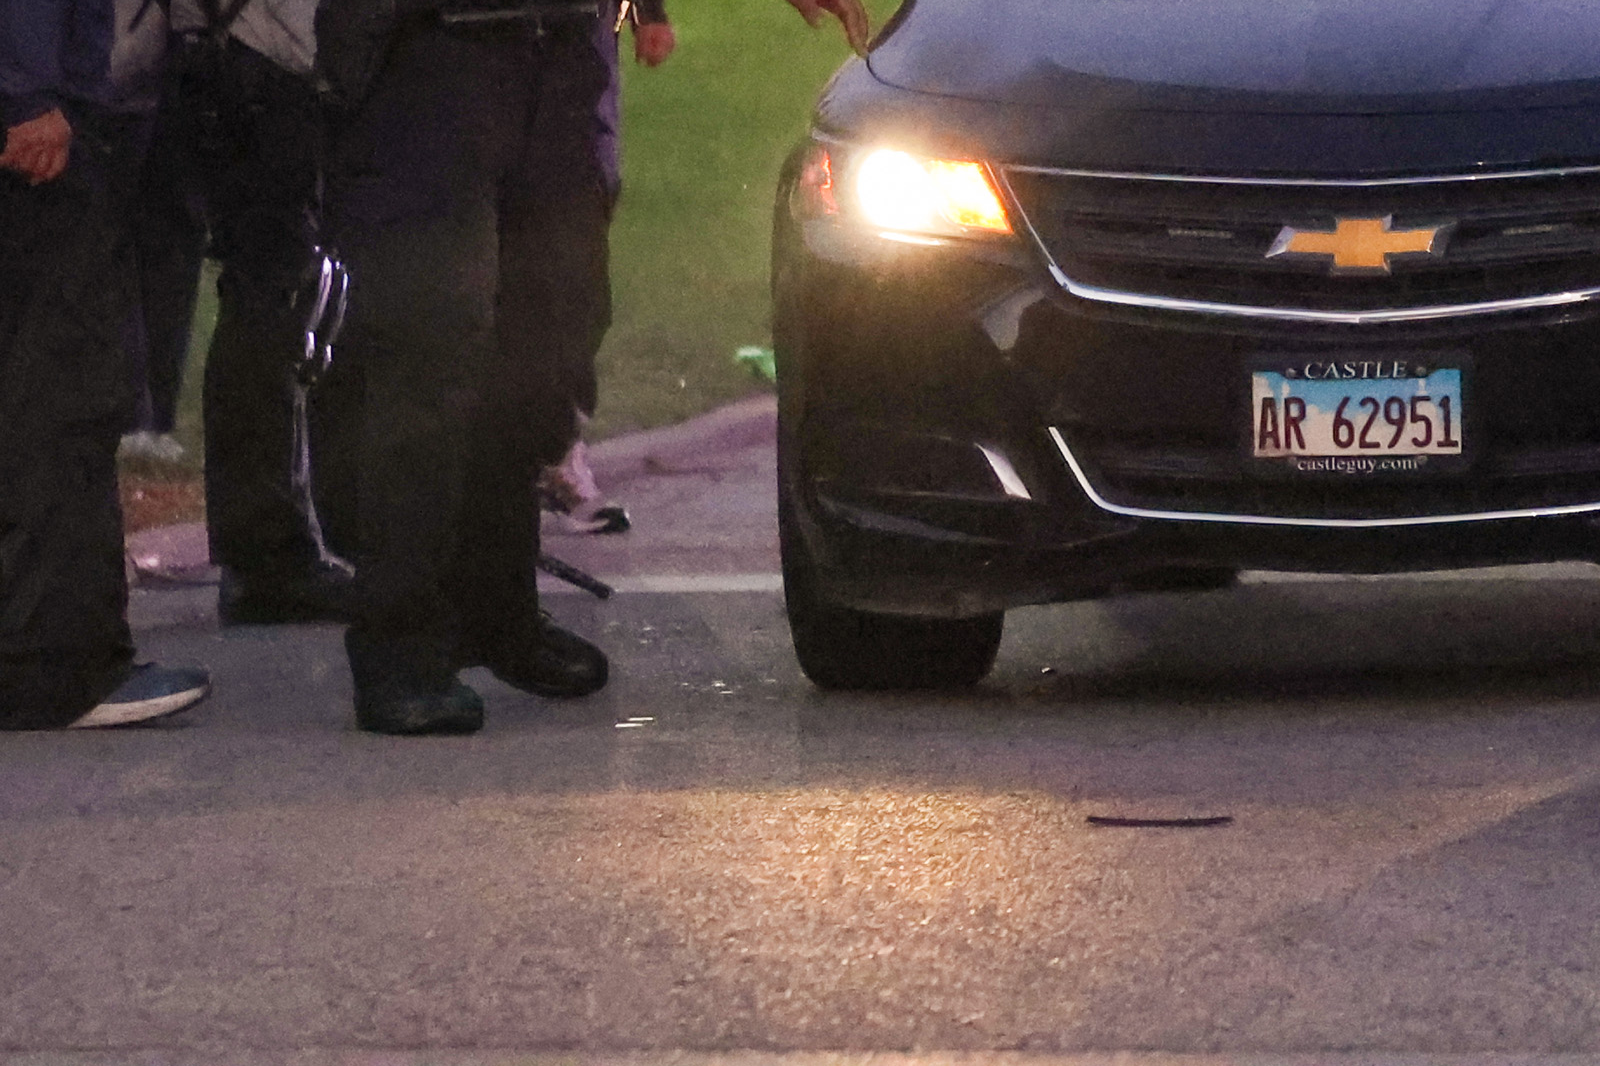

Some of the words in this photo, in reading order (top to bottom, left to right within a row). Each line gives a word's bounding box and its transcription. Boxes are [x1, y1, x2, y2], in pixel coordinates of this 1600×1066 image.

[1304, 361, 1408, 379] CASTLE
[1259, 396, 1306, 450] AR
[1332, 395, 1459, 450] 62951
[1297, 456, 1419, 473] castleguy.com
